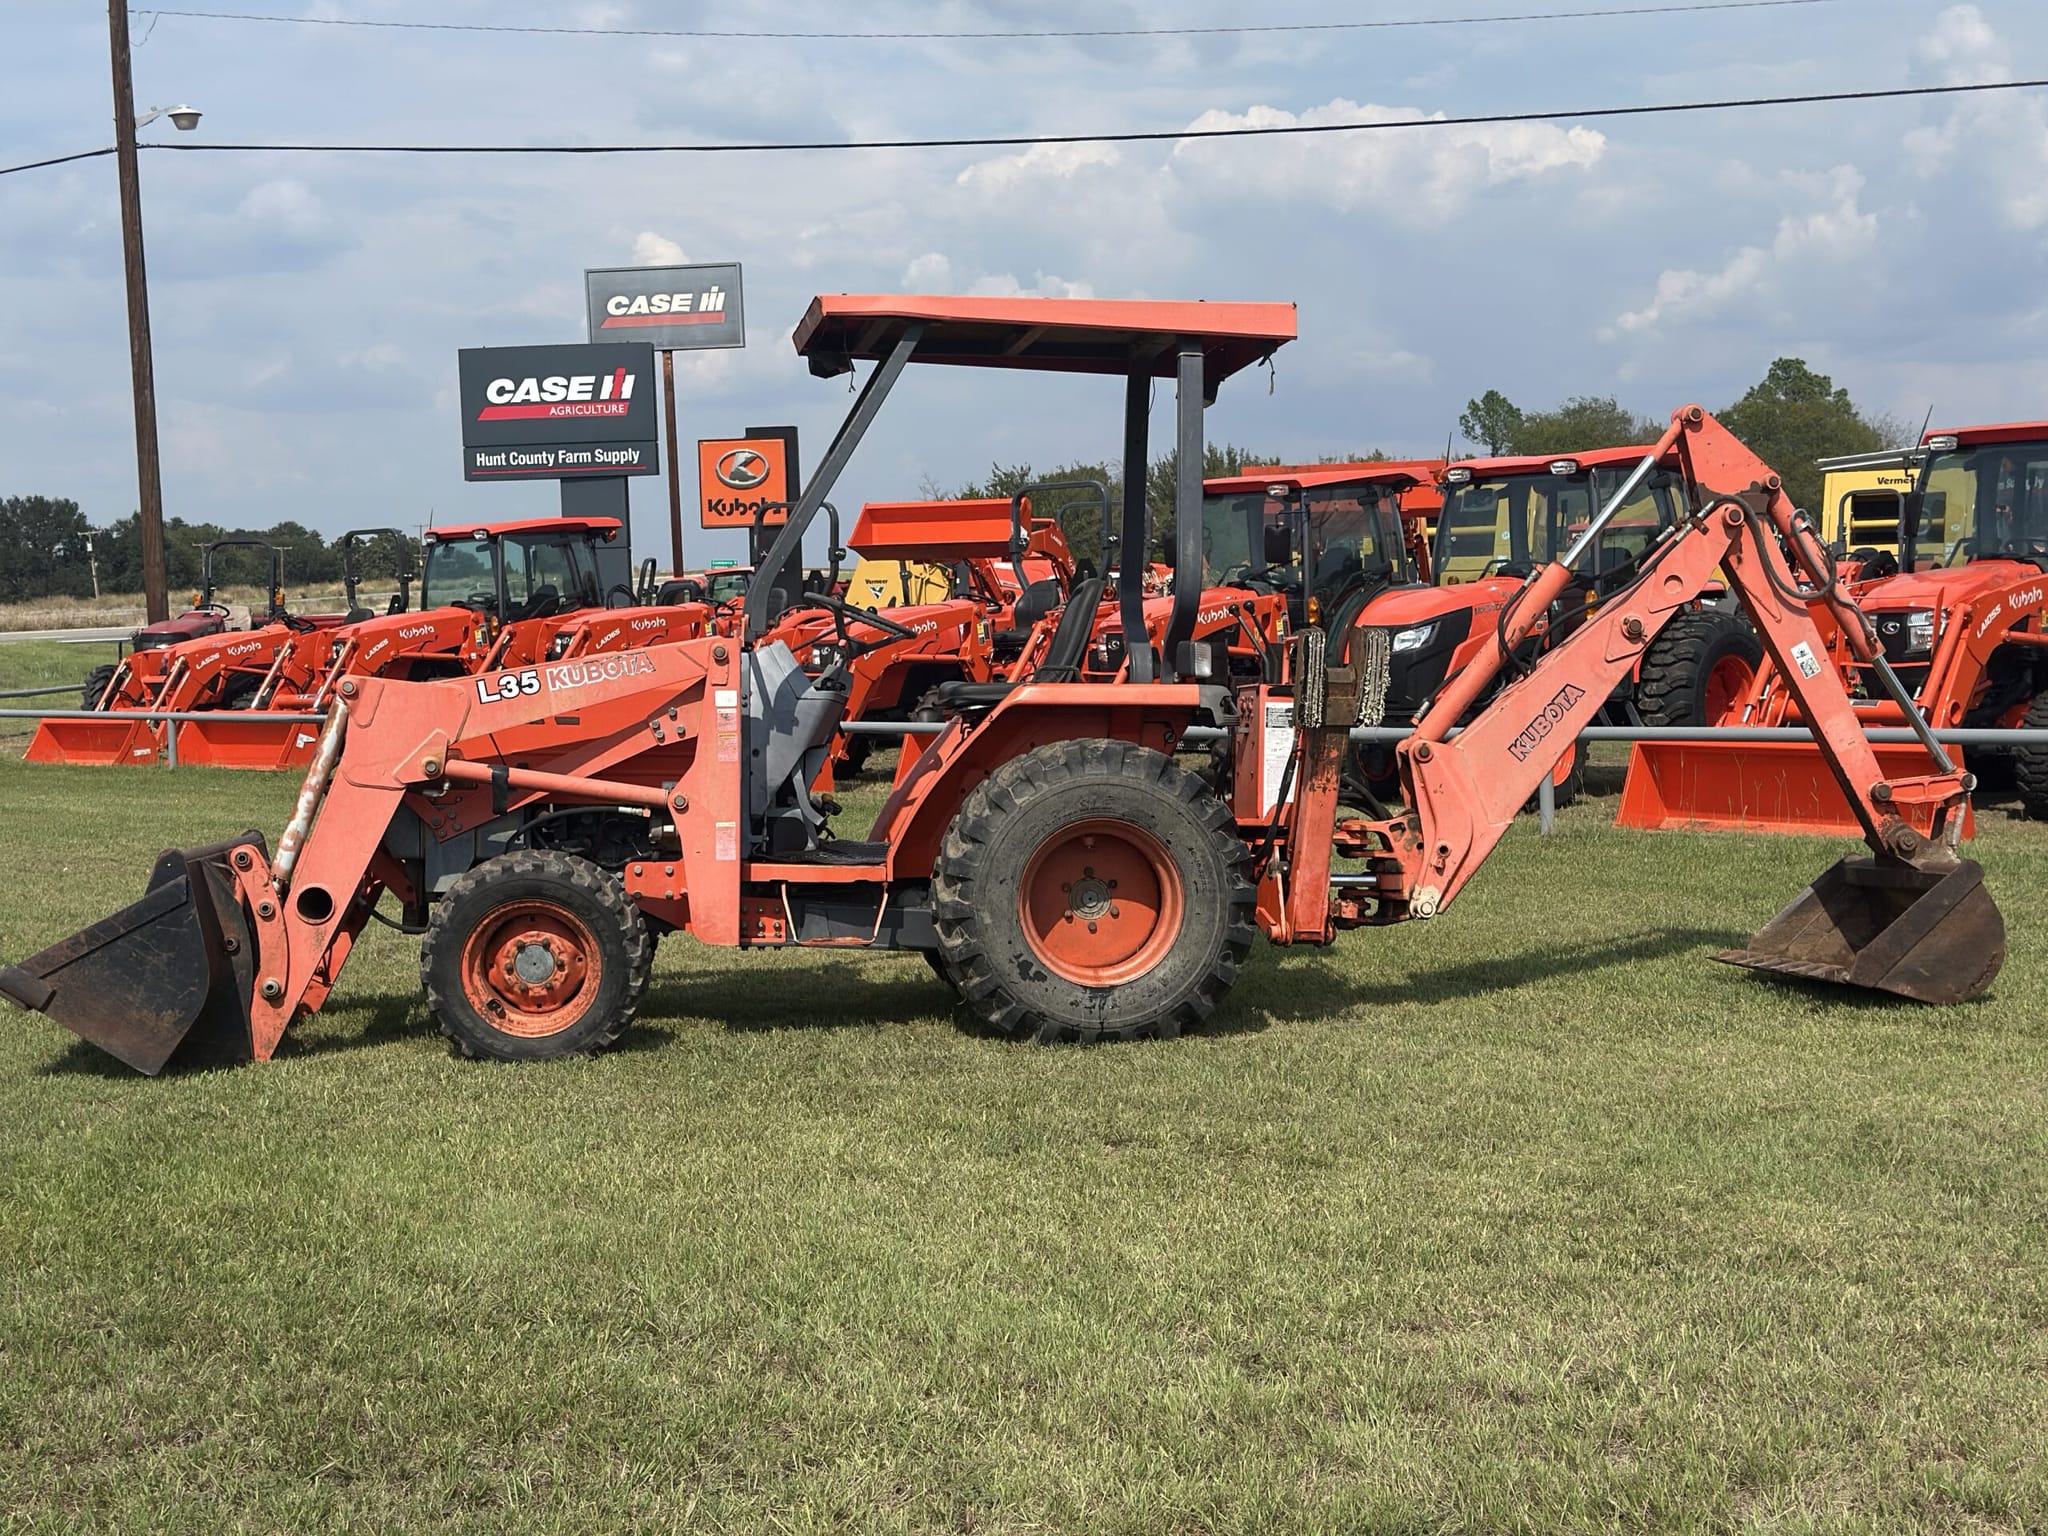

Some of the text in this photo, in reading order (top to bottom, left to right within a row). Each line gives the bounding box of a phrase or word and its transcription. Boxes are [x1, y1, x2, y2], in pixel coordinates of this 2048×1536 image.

[607, 294, 693, 316] CASE
[486, 367, 635, 404] CASE IH
[550, 404, 625, 416] AGRICULTURE
[476, 448, 640, 467] Hunt County Farm Supply
[2009, 586, 2043, 609] Kubota
[399, 624, 435, 639] Kubota
[631, 616, 667, 631] Kubota
[911, 619, 938, 635] bota
[227, 641, 262, 656] Kubota
[476, 652, 656, 704] L35 KUBOTA
[1508, 683, 1586, 761] KUBOTA
